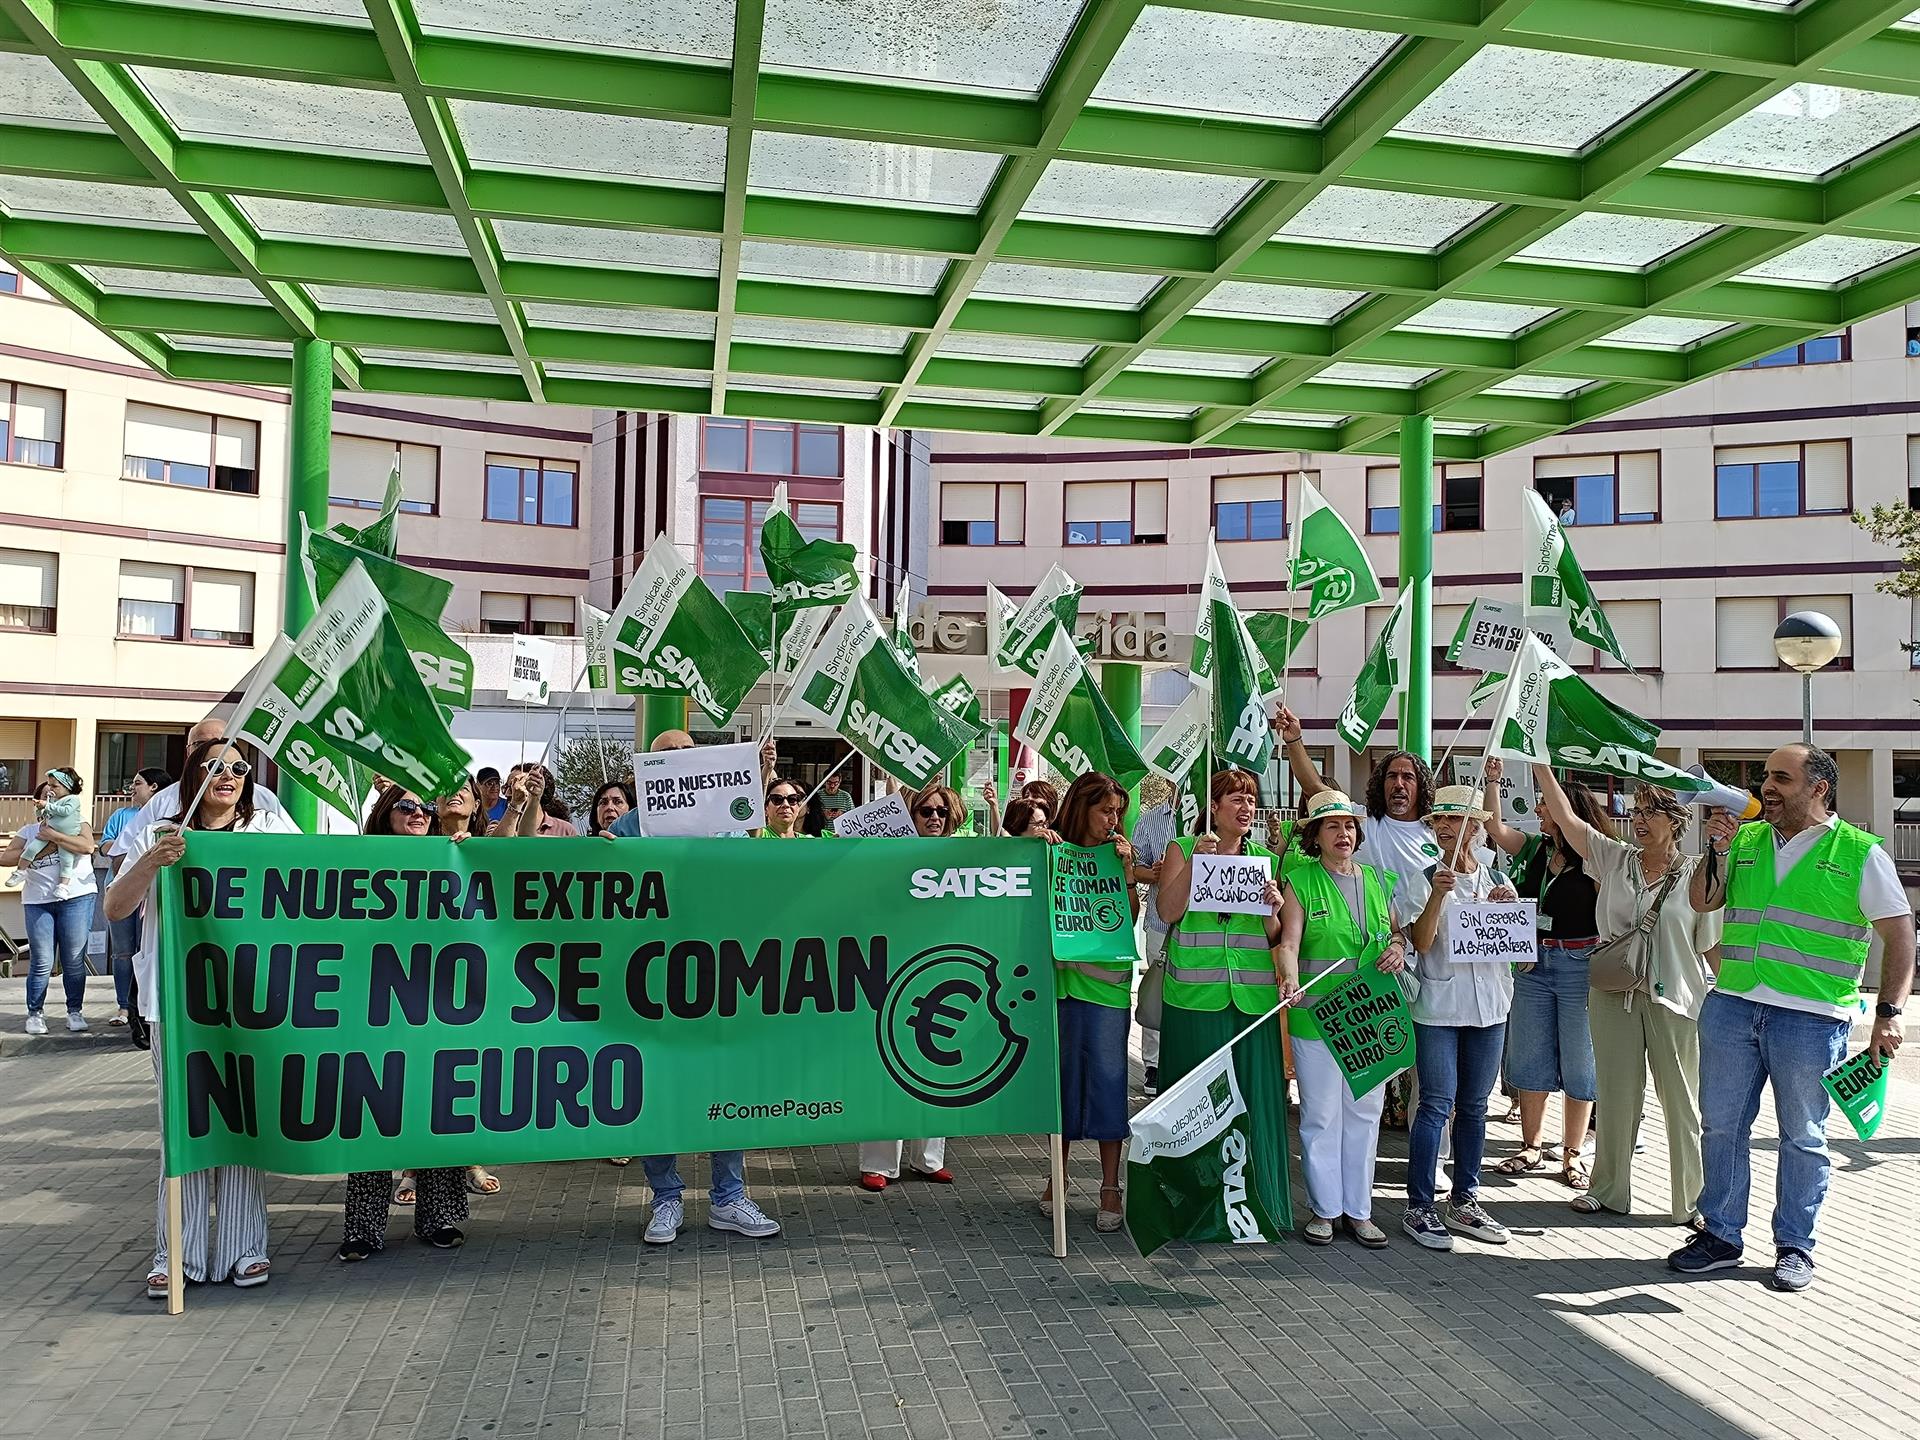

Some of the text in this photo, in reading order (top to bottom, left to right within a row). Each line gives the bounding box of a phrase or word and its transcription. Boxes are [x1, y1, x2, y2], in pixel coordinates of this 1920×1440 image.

[635, 576, 665, 620] Sindicato
[1551, 578, 1561, 605] SATSE
[649, 612, 660, 627] de
[1019, 594, 1049, 629] Sindicato
[635, 627, 650, 651] SATSE
[909, 602, 970, 653] de
[1026, 623, 1037, 634] de
[1476, 621, 1491, 633] ES
[1492, 624, 1507, 637] MI
[825, 623, 855, 675] Sindicato
[1472, 633, 1487, 646] ES
[1488, 637, 1504, 649] MI
[515, 655, 539, 670] MI EXTRA
[1200, 642, 1212, 674] SATS
[514, 667, 540, 682] NO SE TOCA
[655, 645, 729, 720] SATSE
[840, 665, 849, 682] de
[823, 682, 841, 712] SATSE
[1044, 700, 1055, 713] de
[263, 718, 280, 742] SATSE
[1028, 714, 1044, 737] SATSE
[1524, 719, 1538, 735] de
[848, 699, 941, 780] SATSE
[644, 759, 666, 767] SATSE
[1050, 732, 1094, 778] SAT
[1183, 748, 1192, 758] de
[1558, 745, 1677, 778] SATS
[286, 739, 356, 812] SATS
[645, 770, 752, 796] POR NUESTRAS
[1460, 776, 1471, 786] DE
[646, 792, 696, 812] PAGAS
[858, 822, 888, 838] PAGAD
[1057, 857, 1097, 876] QUE NO
[1202, 861, 1216, 884] Y
[182, 866, 670, 921] DE NUESTRA EXTRA
[909, 867, 1033, 899] SATSE
[1055, 876, 1121, 894] SE COMAN
[1055, 895, 1091, 913] NI UN
[1055, 914, 1095, 932] EURO
[1474, 927, 1509, 940] PAGAD
[1453, 940, 1466, 954] LA
[185, 935, 888, 1030] QUE NO SE COMAN
[1315, 982, 1371, 1021] QUE NO
[1322, 991, 1401, 1038] SE COMAN
[1331, 1023, 1377, 1055] NI UN
[1342, 1043, 1385, 1074] EURO
[186, 1043, 644, 1143] NI UN EURO
[1833, 1060, 1882, 1102] EURO
[707, 1099, 844, 1121] #ComePagas
